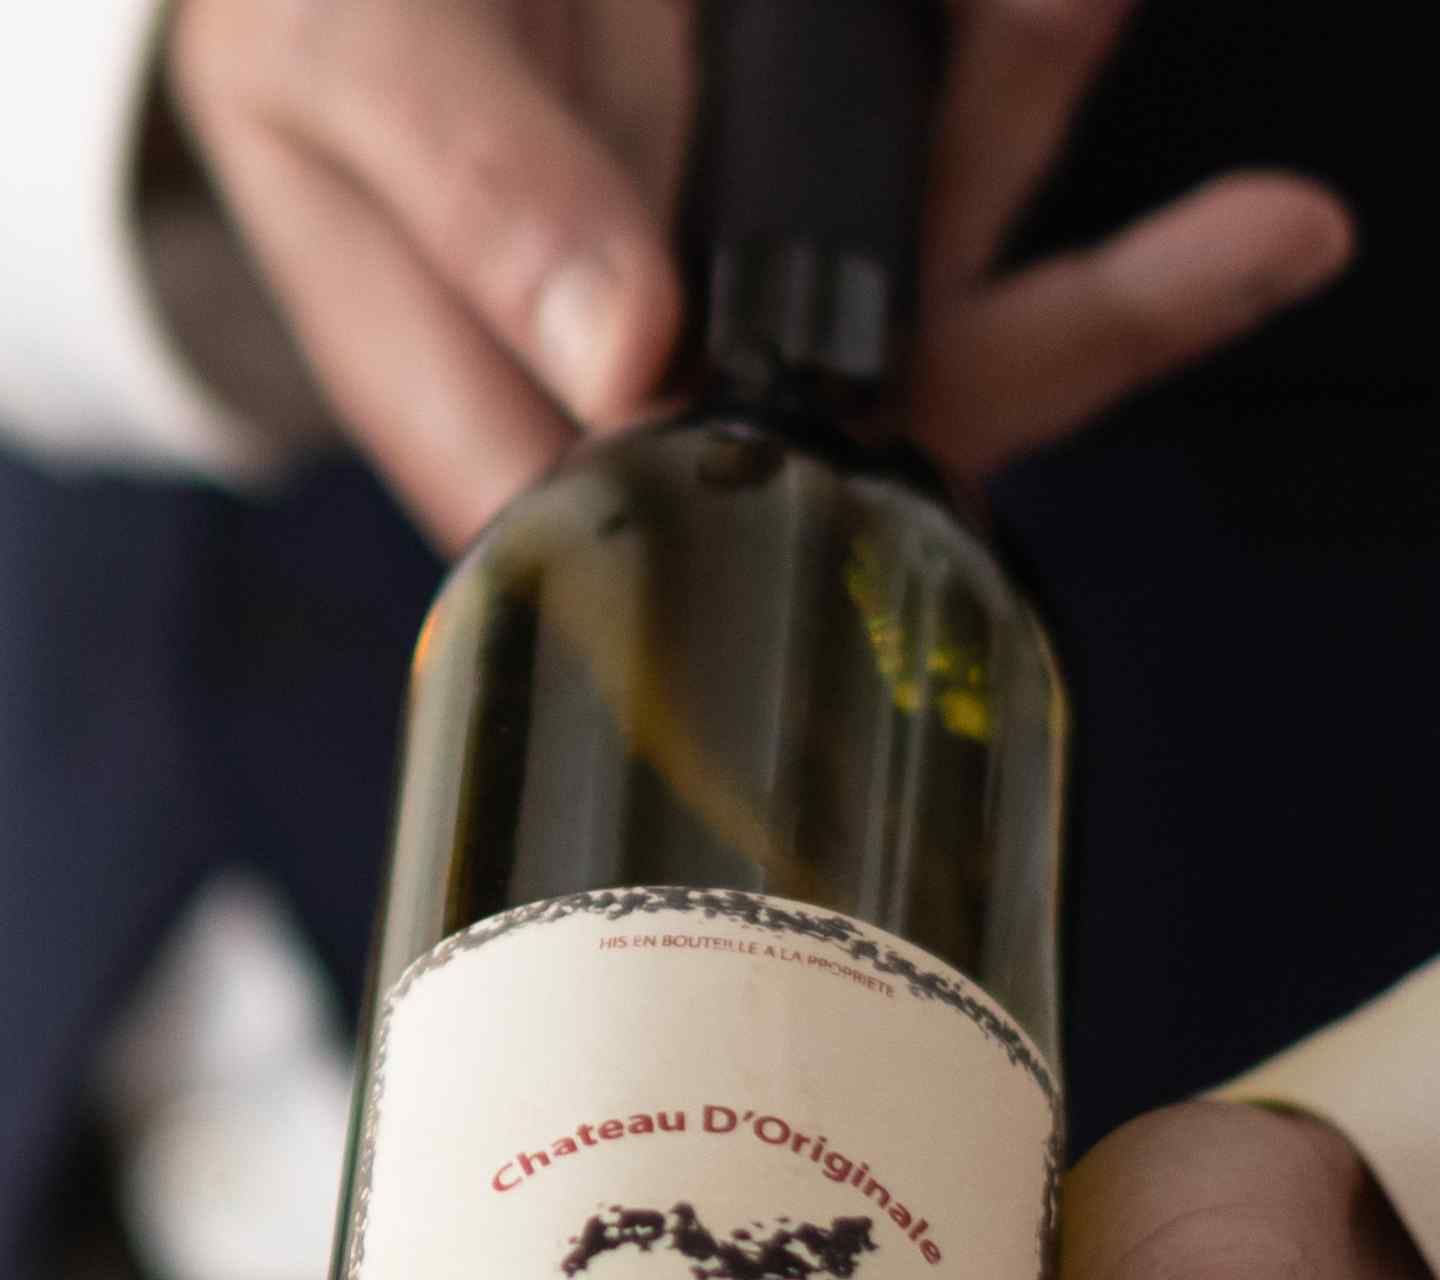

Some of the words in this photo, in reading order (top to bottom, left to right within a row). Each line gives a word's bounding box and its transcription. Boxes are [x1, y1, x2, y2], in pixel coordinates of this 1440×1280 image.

[633, 935, 657, 948] EN
[662, 934, 758, 955] BOUTEILLE
[764, 944, 776, 958] A
[780, 948, 802, 962] LA
[491, 1109, 687, 1193] Chateau
[702, 1103, 943, 1266] D'Originale
